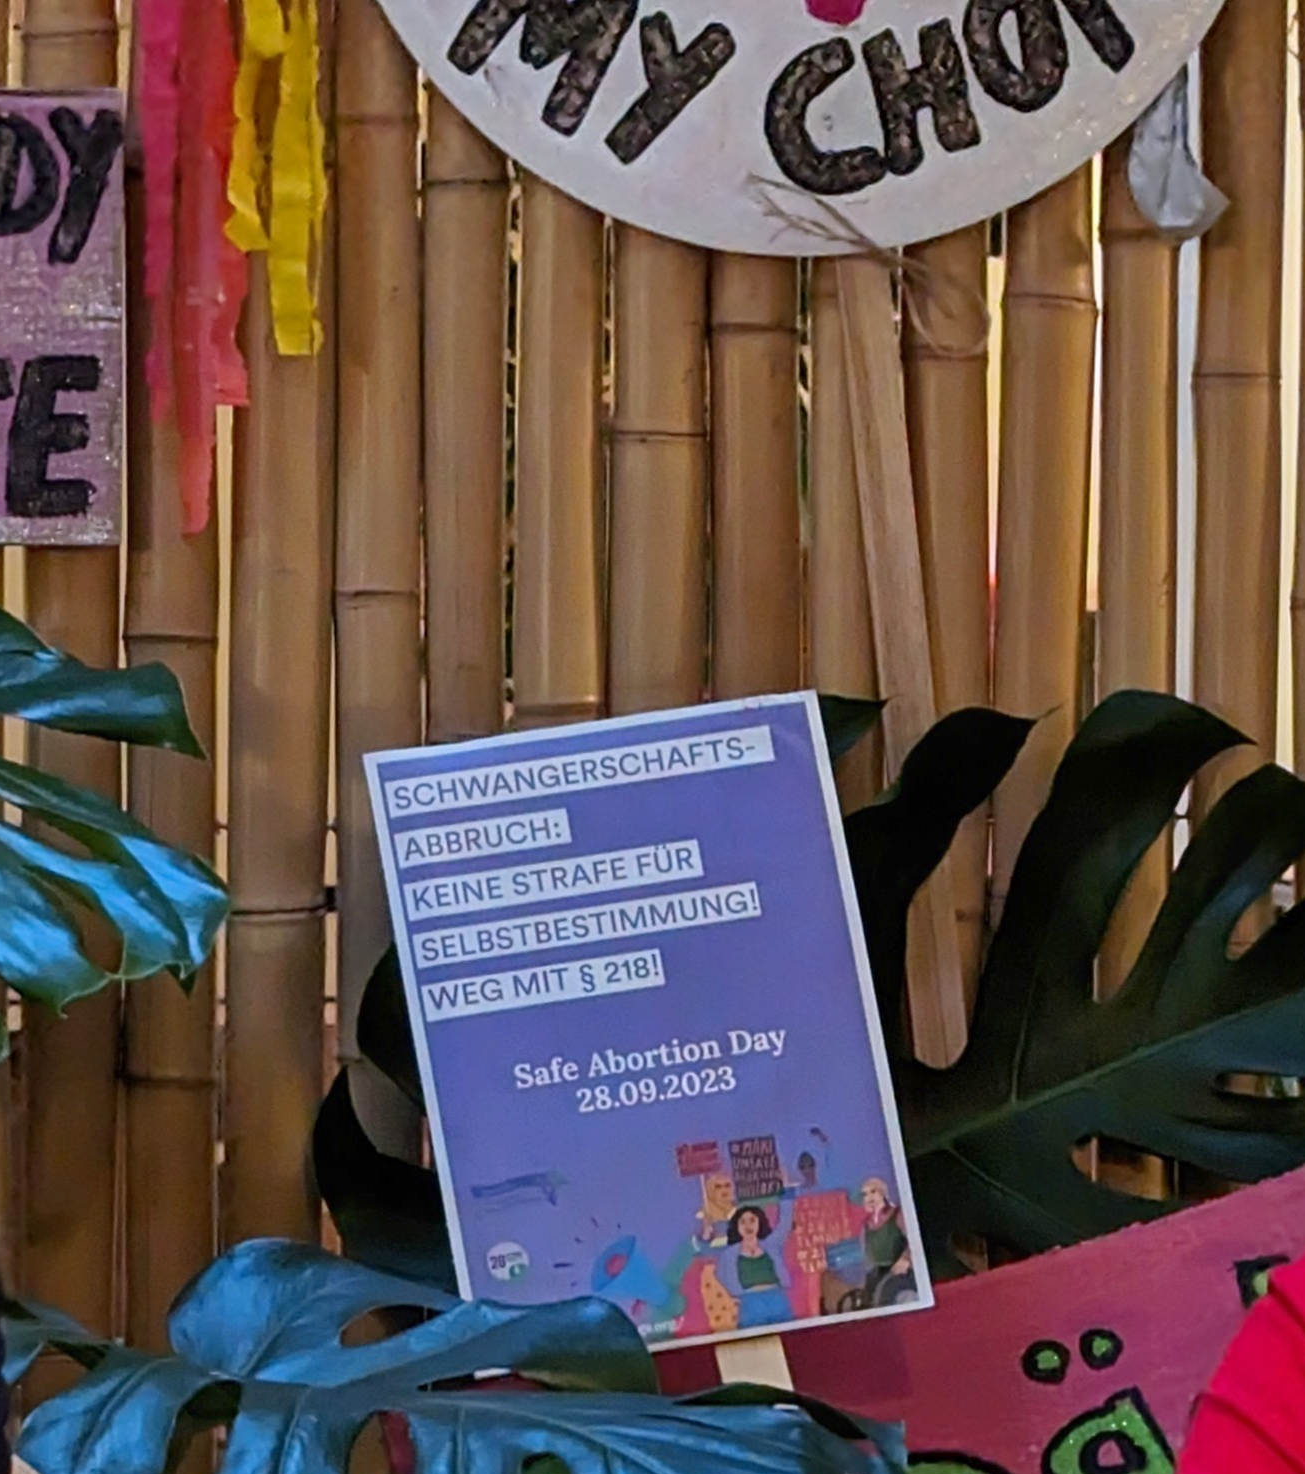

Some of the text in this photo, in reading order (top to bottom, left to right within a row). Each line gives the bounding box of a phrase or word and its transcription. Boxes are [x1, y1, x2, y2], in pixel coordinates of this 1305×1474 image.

[447, 0, 736, 165] MY
[393, 736, 757, 811] SCHWANGERSCHAFTS-
[403, 817, 563, 862] ABBRUCH:
[411, 843, 695, 912] KEINE STRAFE FÜR
[420, 889, 761, 963] SELBSTBESTIMMUNG!
[426, 950, 660, 1012] WEG MIT § 218!
[513, 1028, 787, 1089] Safe Abortion Day
[575, 1067, 737, 1113] 28.09.2023
